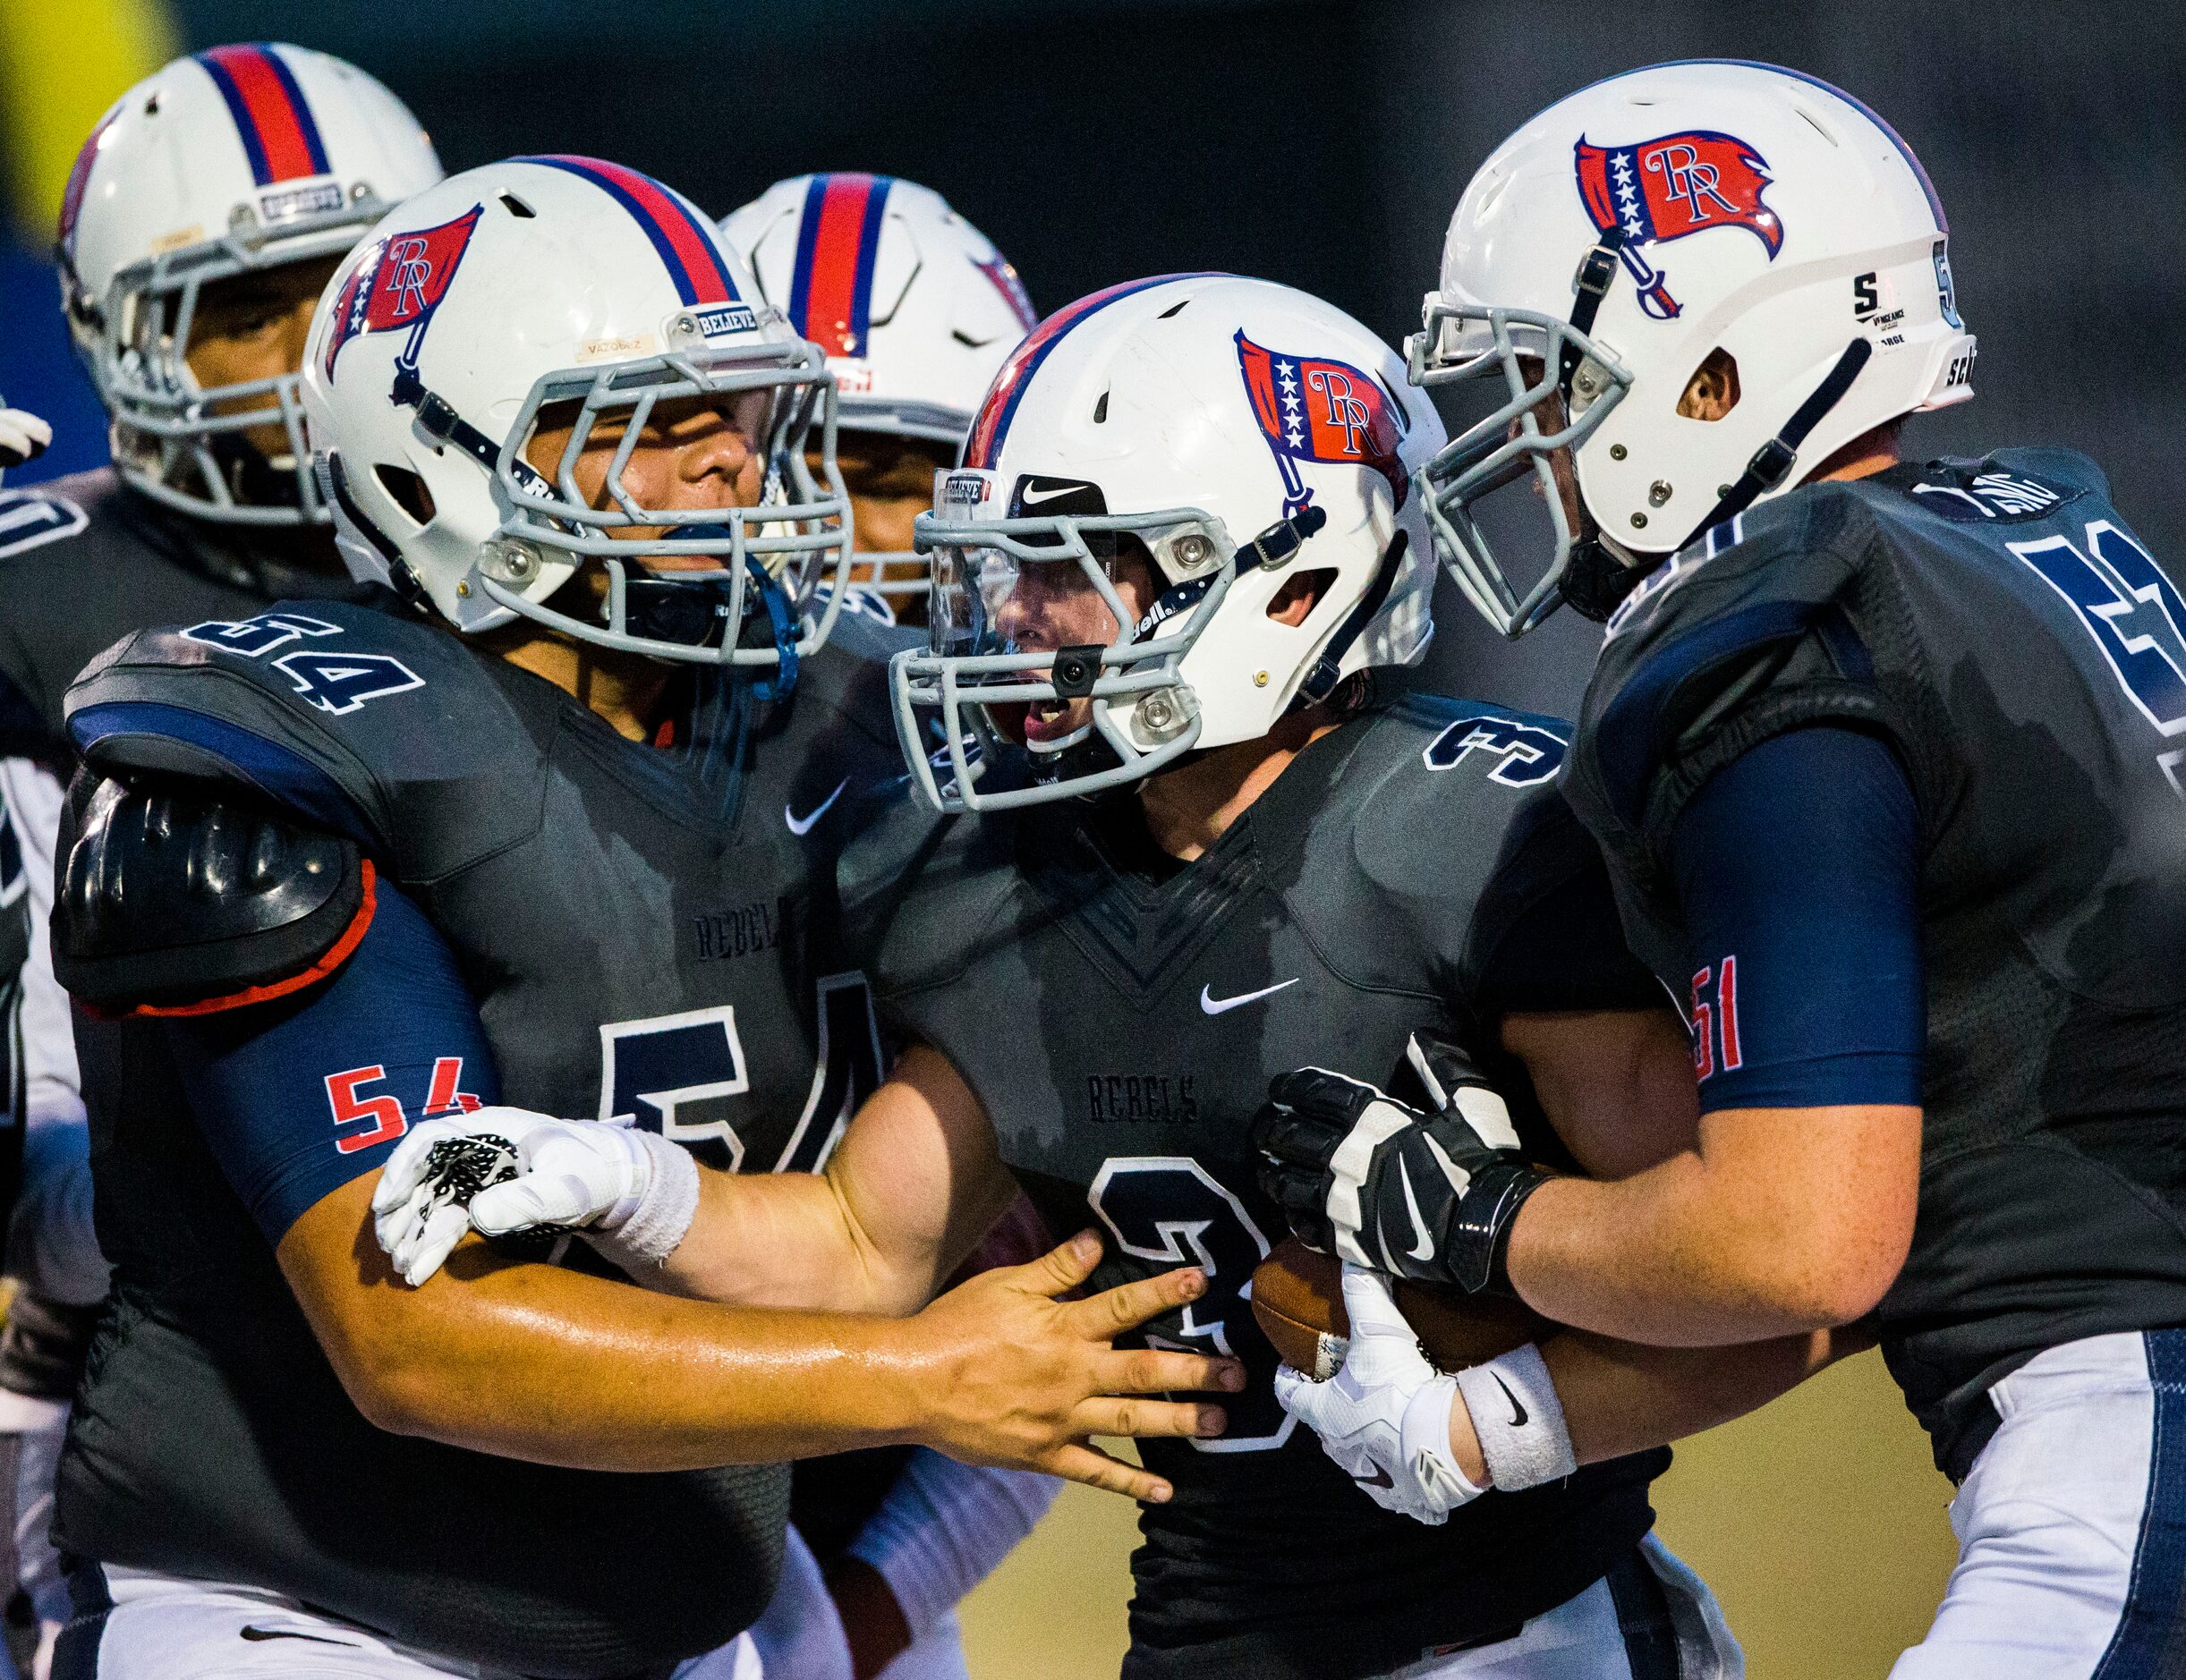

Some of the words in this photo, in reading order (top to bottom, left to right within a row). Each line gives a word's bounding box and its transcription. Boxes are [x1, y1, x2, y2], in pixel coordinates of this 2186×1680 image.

[699, 310, 756, 335] BELIEVE
[1854, 271, 1878, 315] S
[180, 614, 427, 716] 54
[1422, 716, 1569, 788] 3
[693, 896, 789, 963] REBEL
[1689, 955, 1743, 1083] 51
[324, 1056, 483, 1154] 54
[1087, 1074, 1197, 1122] REBELS
